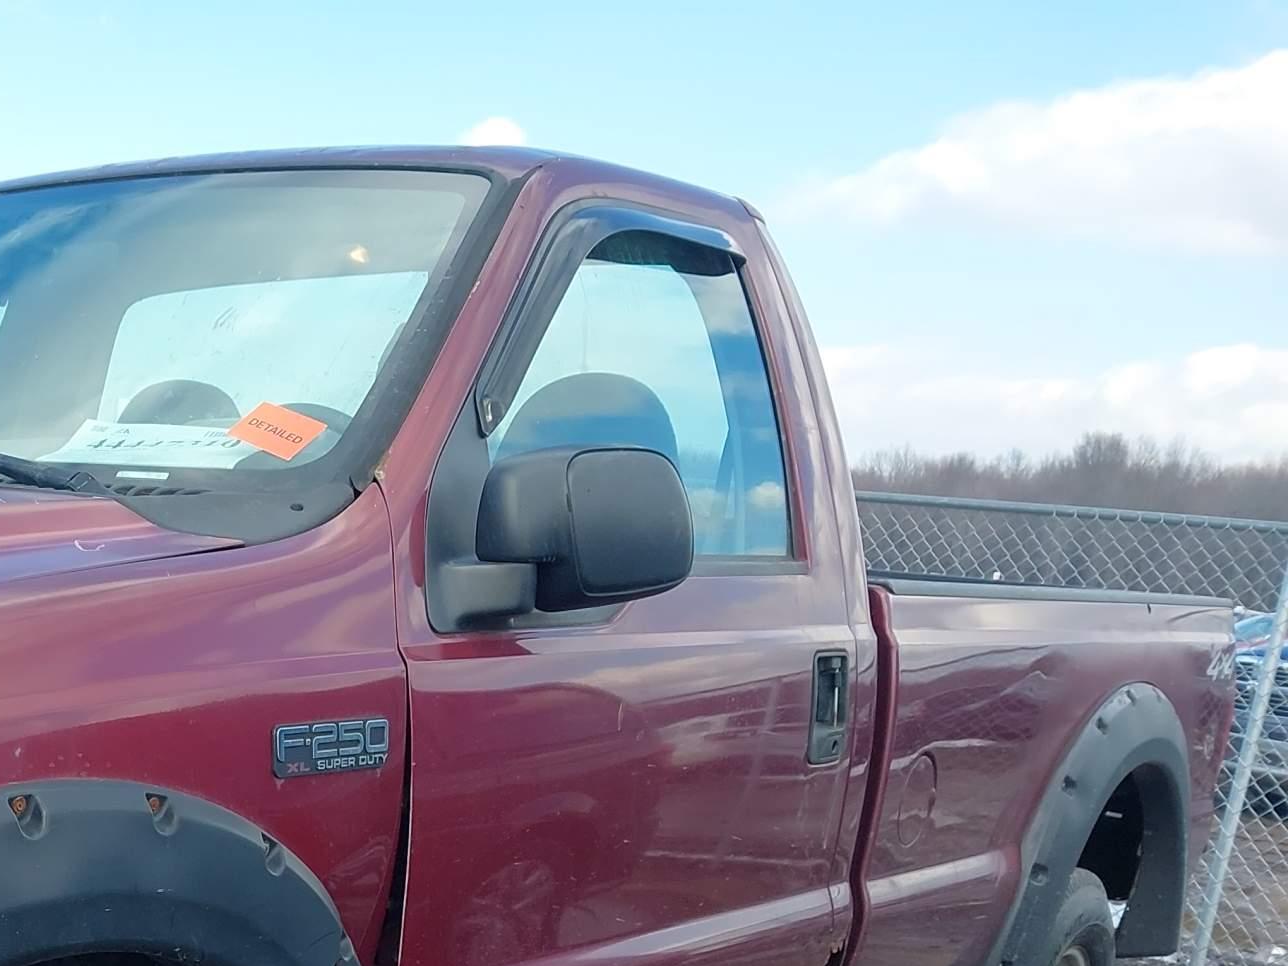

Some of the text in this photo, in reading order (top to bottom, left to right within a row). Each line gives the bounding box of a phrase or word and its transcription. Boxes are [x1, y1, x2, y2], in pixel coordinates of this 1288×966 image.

[248, 417, 304, 445] DETAILED
[287, 753, 389, 774] XL SUPER DUTY
